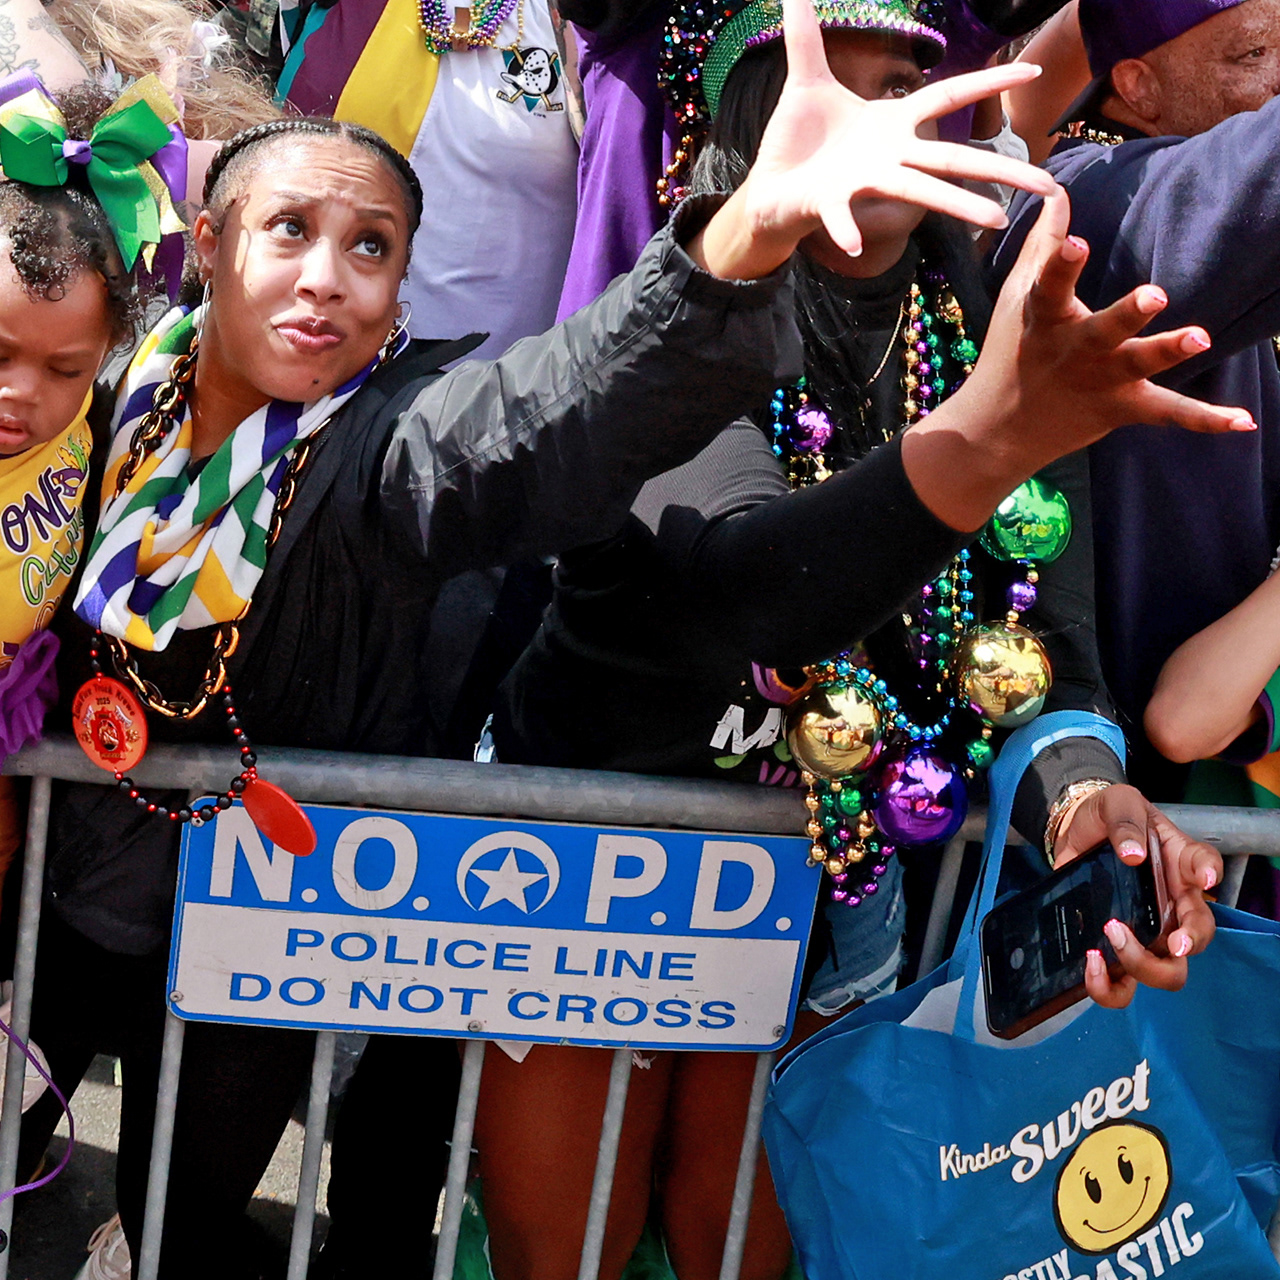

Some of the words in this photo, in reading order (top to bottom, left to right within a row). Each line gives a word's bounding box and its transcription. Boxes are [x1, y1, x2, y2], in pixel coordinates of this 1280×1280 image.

[0, 466, 77, 555] ONE
[284, 927, 531, 973] POLICE
[553, 945, 698, 982] LINE
[228, 972, 325, 1006] DO
[348, 982, 490, 1016] NOT
[507, 989, 737, 1031] CROSS
[939, 1141, 1012, 1182] Kinda
[1010, 1058, 1151, 1183] Sweet
